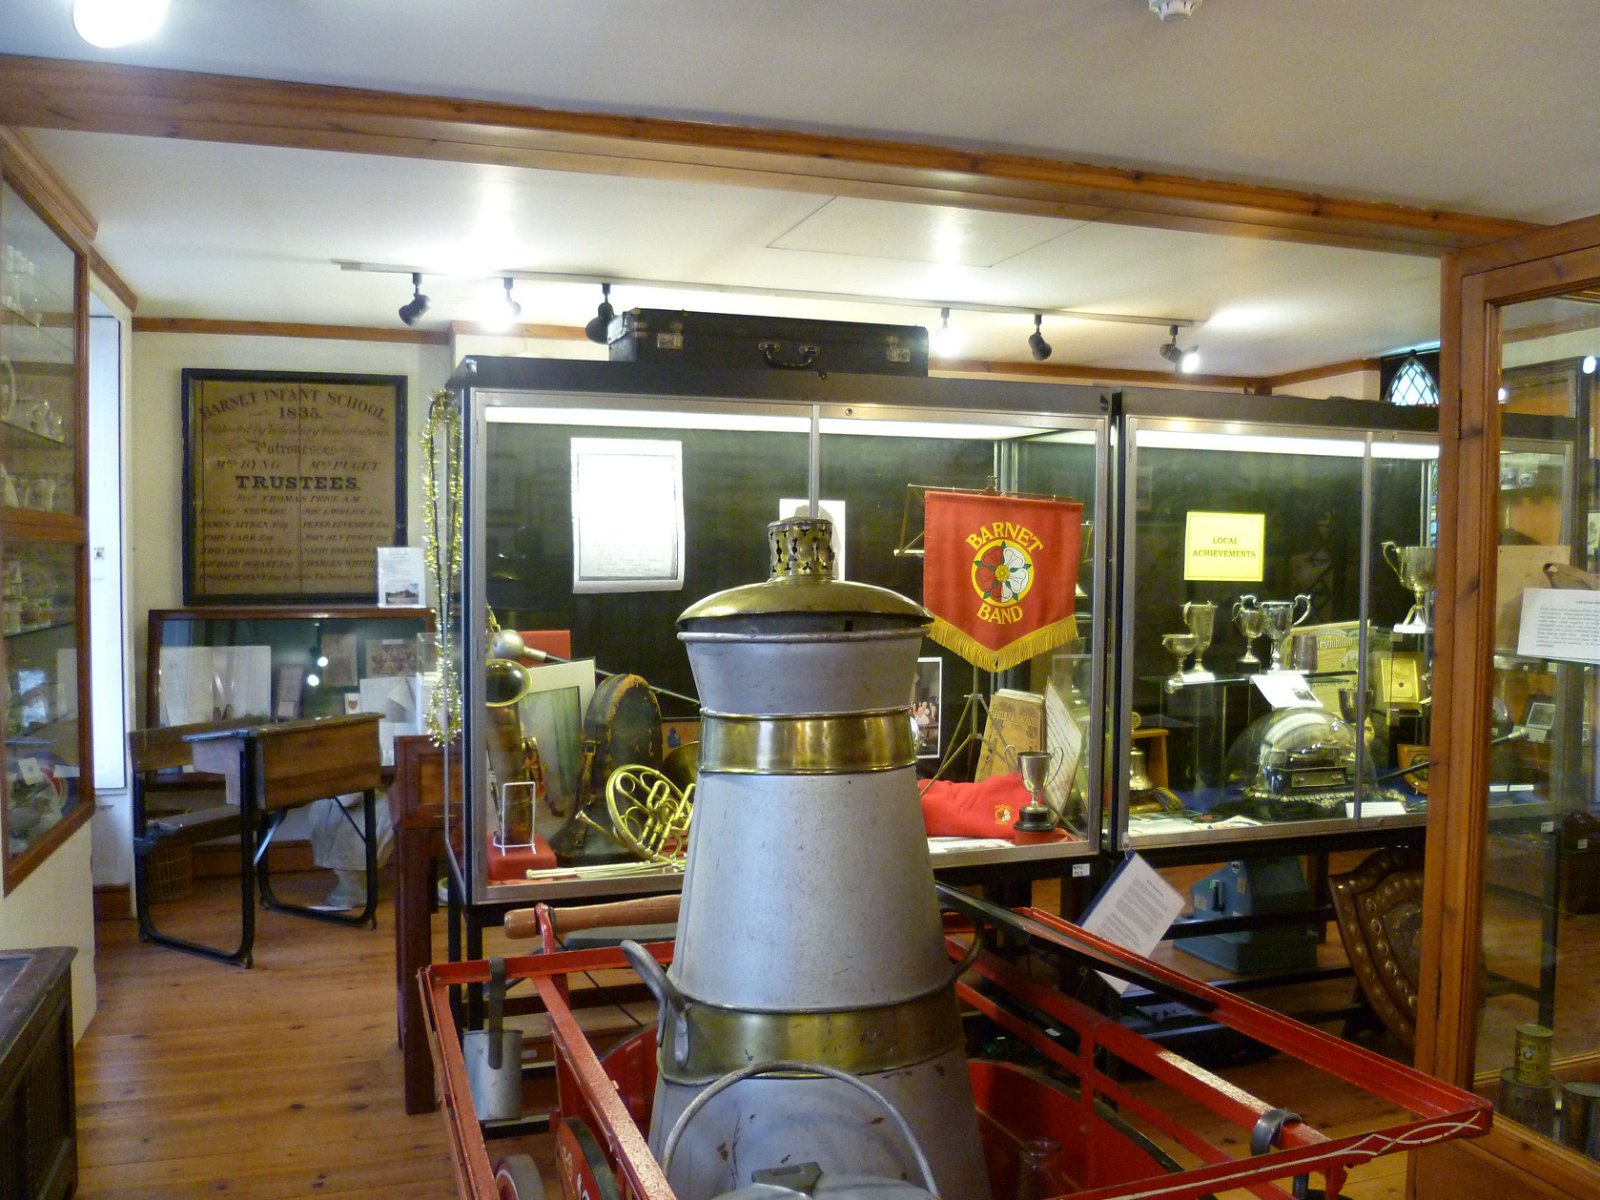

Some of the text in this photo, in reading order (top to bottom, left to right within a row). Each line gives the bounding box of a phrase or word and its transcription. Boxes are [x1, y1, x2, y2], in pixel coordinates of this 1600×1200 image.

[199, 390, 258, 419] BARNET
[263, 388, 322, 402] INFANT
[965, 521, 1043, 554] BARNET
[1212, 537, 1239, 545] LOCAL
[1192, 549, 1257, 559] ACHIEVEMENTS
[976, 602, 1023, 625] BAND
